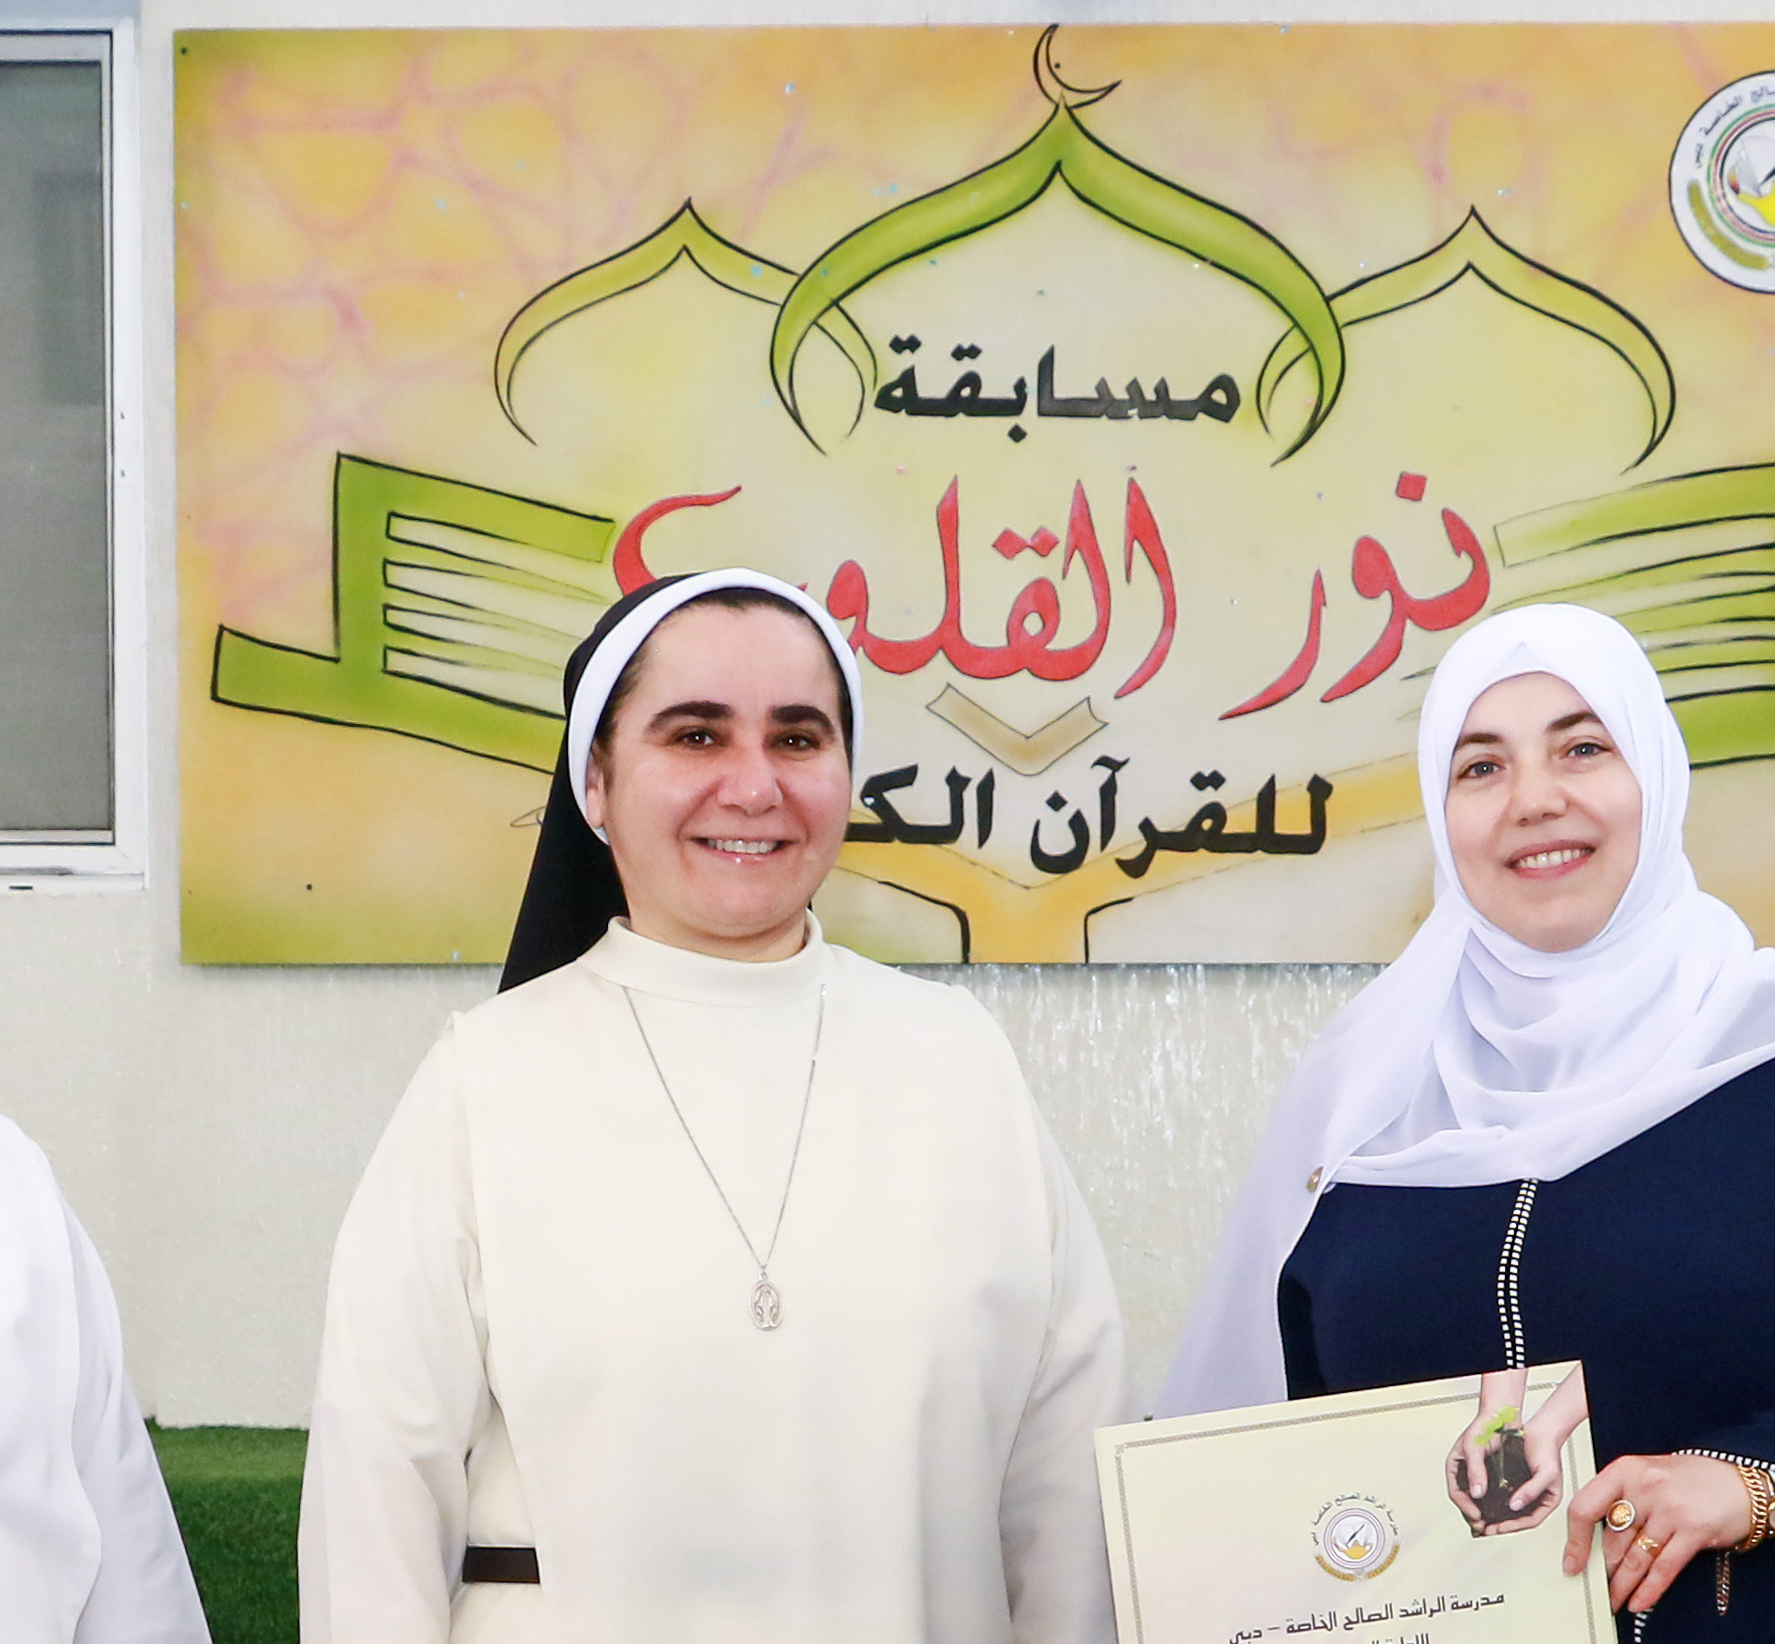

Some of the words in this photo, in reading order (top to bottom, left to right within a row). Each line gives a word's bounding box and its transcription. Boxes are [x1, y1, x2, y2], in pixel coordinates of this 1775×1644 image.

[874, 334, 1241, 443] مسابقة
[1218, 471, 1491, 721] نور
[843, 764, 995, 849] الك
[1029, 756, 1334, 879] للقرآن
[1286, 1611, 1338, 1634] الخاصة
[1343, 1603, 1393, 1630] الصالح
[1398, 1596, 1446, 1618] الراشد
[1450, 1593, 1505, 1612] مدرسة
